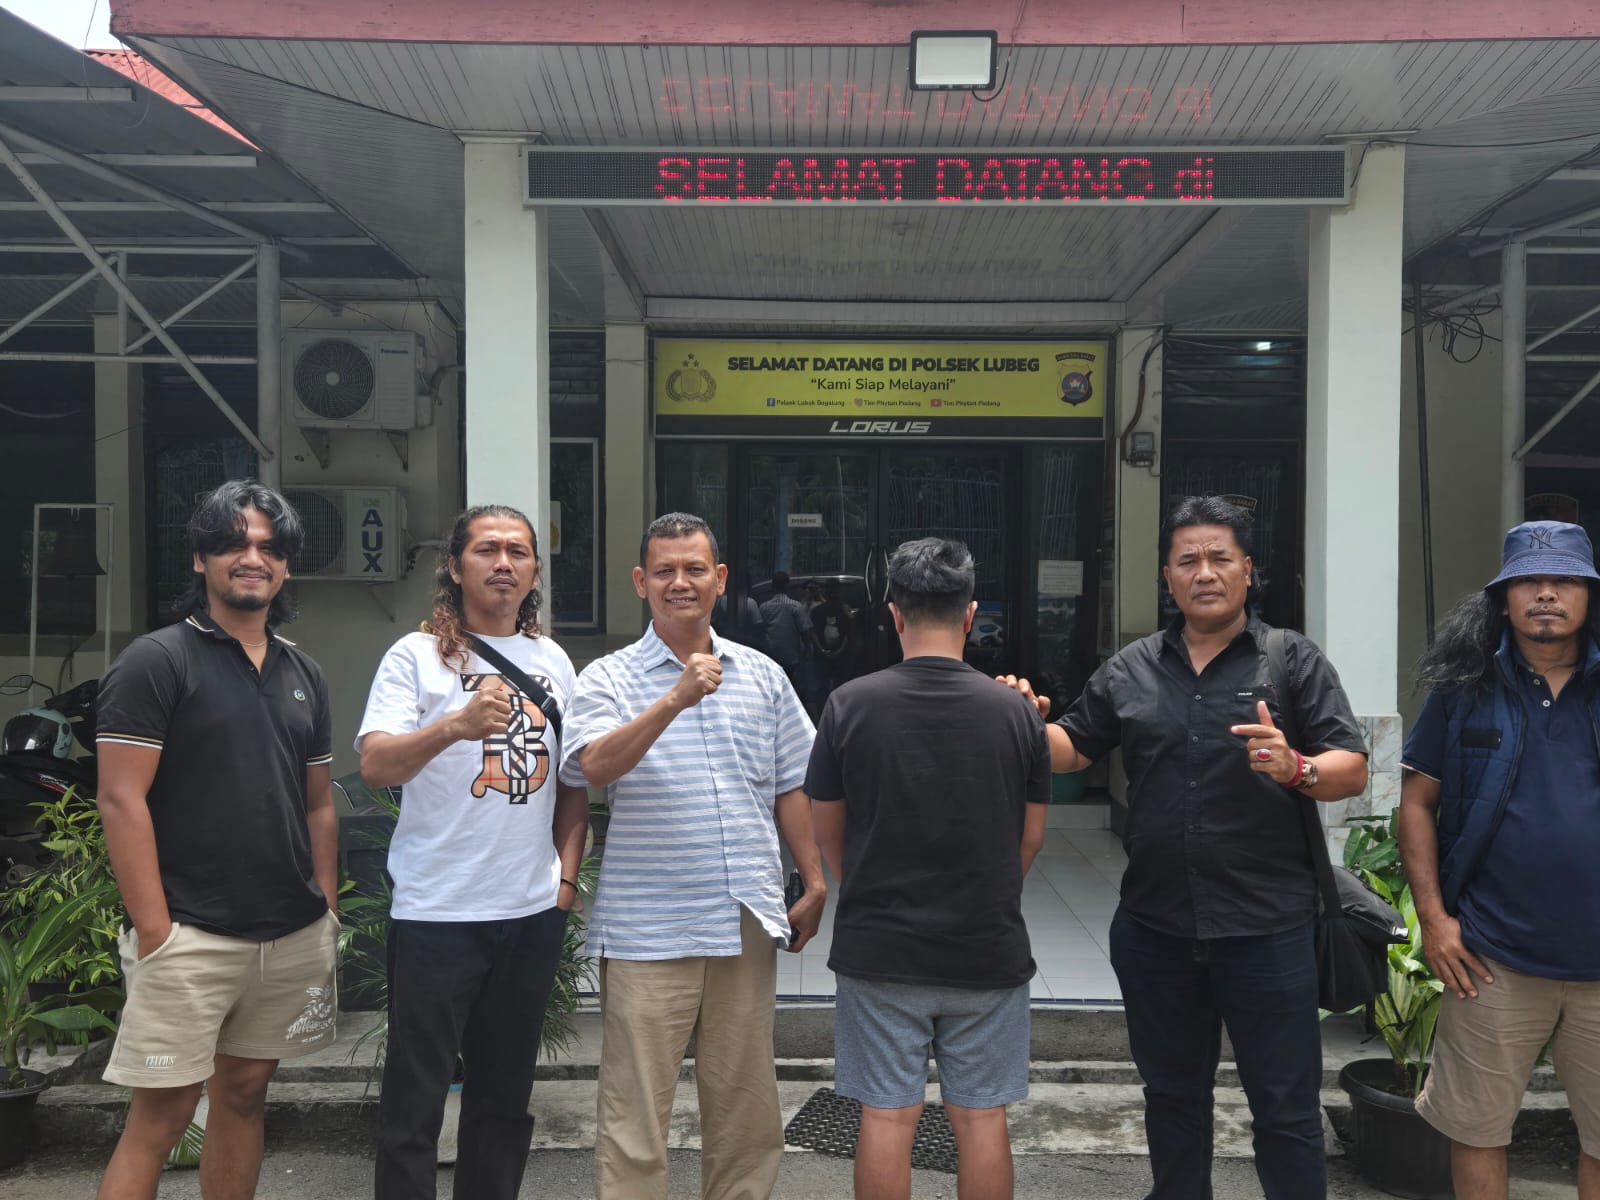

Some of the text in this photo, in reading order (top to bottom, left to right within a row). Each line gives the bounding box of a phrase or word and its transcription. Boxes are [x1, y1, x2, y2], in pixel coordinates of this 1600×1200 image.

[656, 158, 1213, 201] SELAMAT DATANG di
[728, 357, 1040, 372] SELAMAT DATANG DI POLSEK LUBEG
[855, 378, 885, 392] Siap
[829, 420, 932, 433] LORUS
[361, 509, 383, 573] AUX
